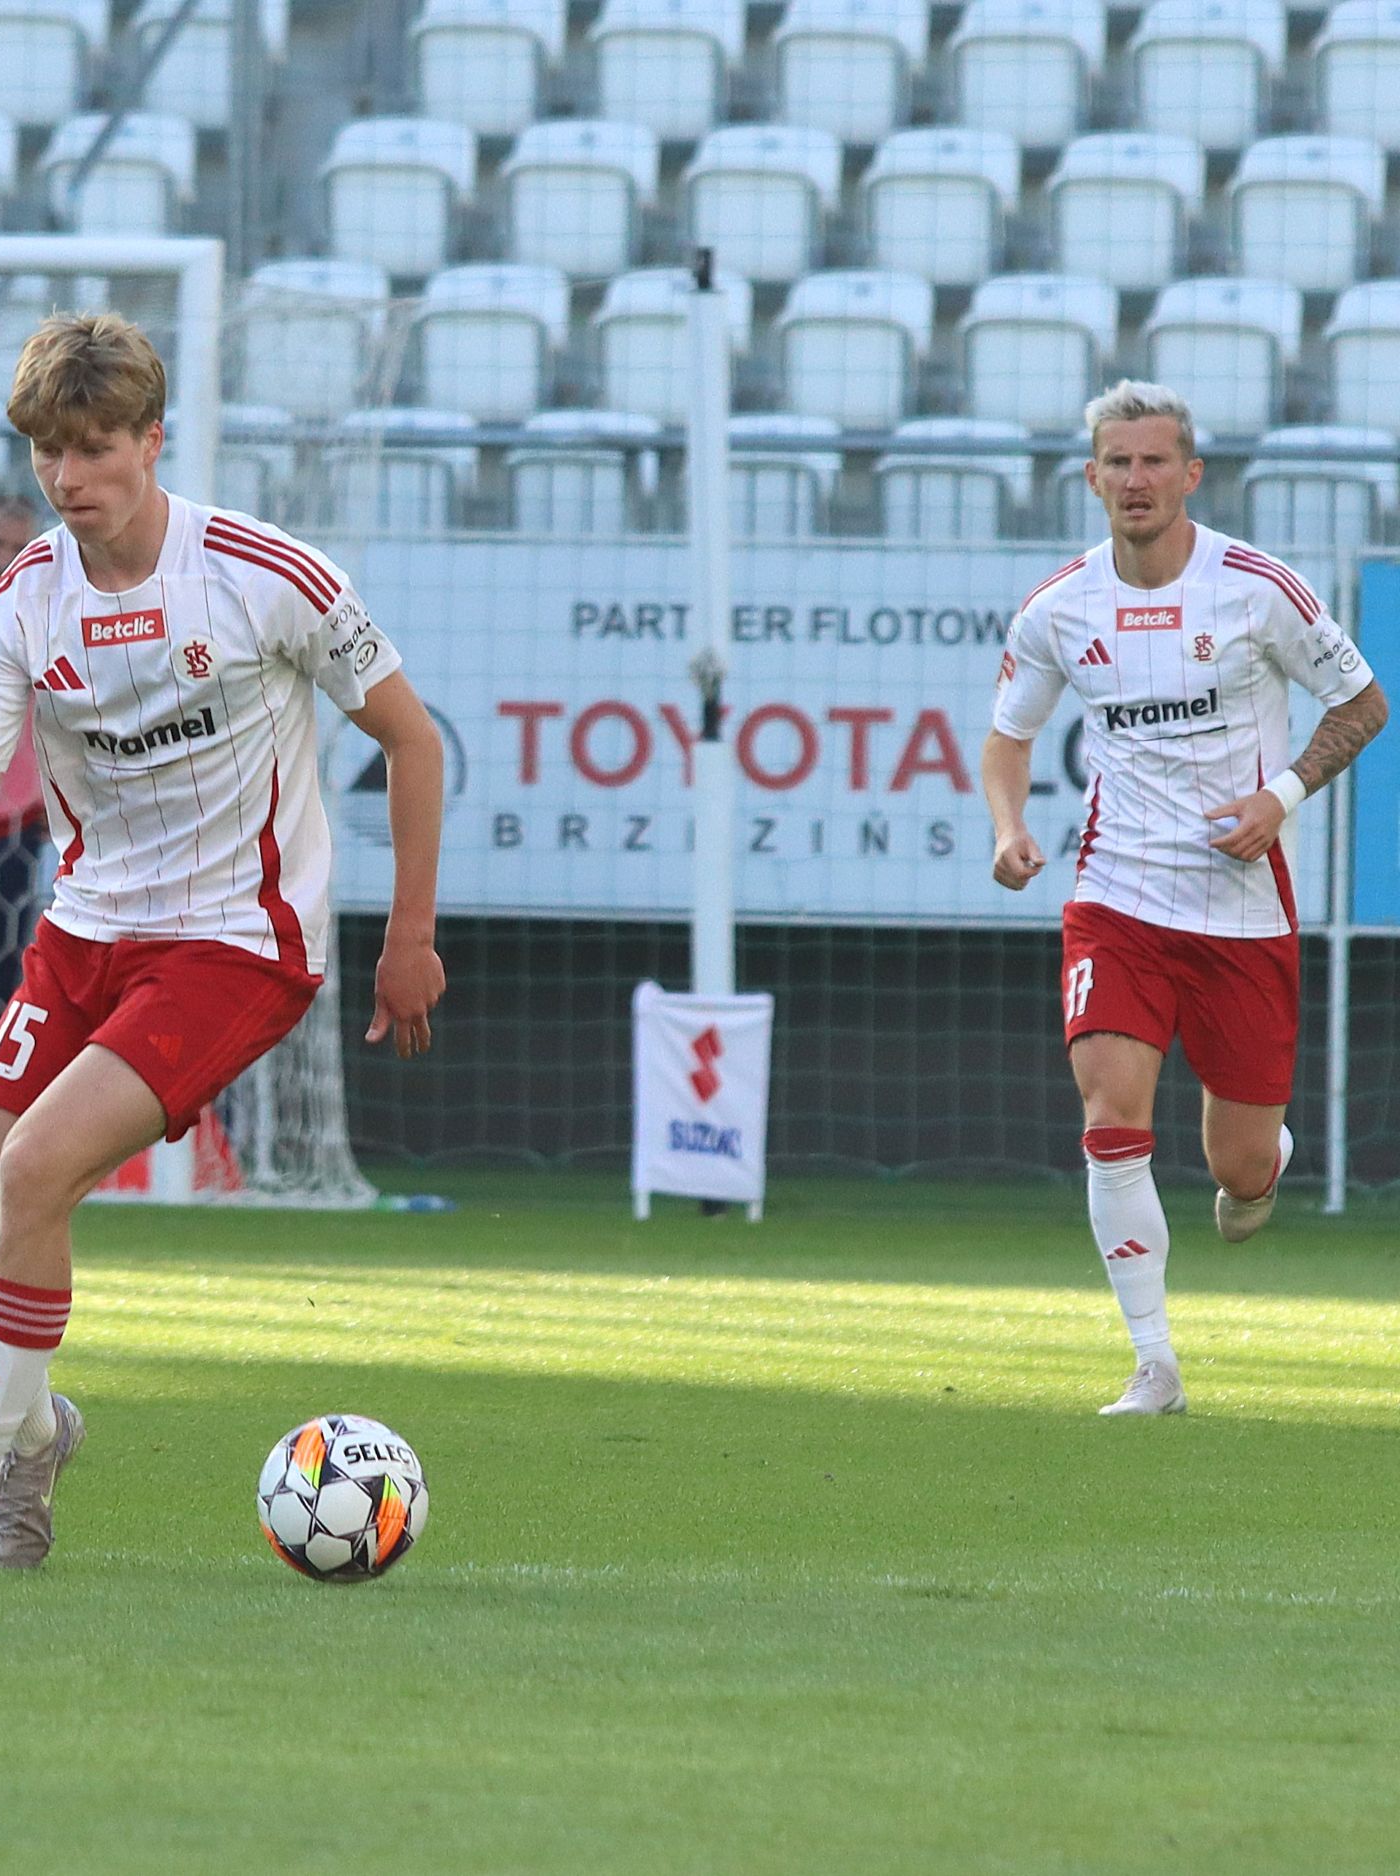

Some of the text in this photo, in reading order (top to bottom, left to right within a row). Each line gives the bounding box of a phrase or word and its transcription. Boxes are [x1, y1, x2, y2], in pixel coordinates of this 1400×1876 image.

[90, 616, 156, 642] Betclic
[571, 602, 795, 643] PARTER
[1123, 611, 1176, 627] Betclic
[1104, 688, 1218, 731] Kramel
[493, 811, 1081, 858] BRZZIŃSA
